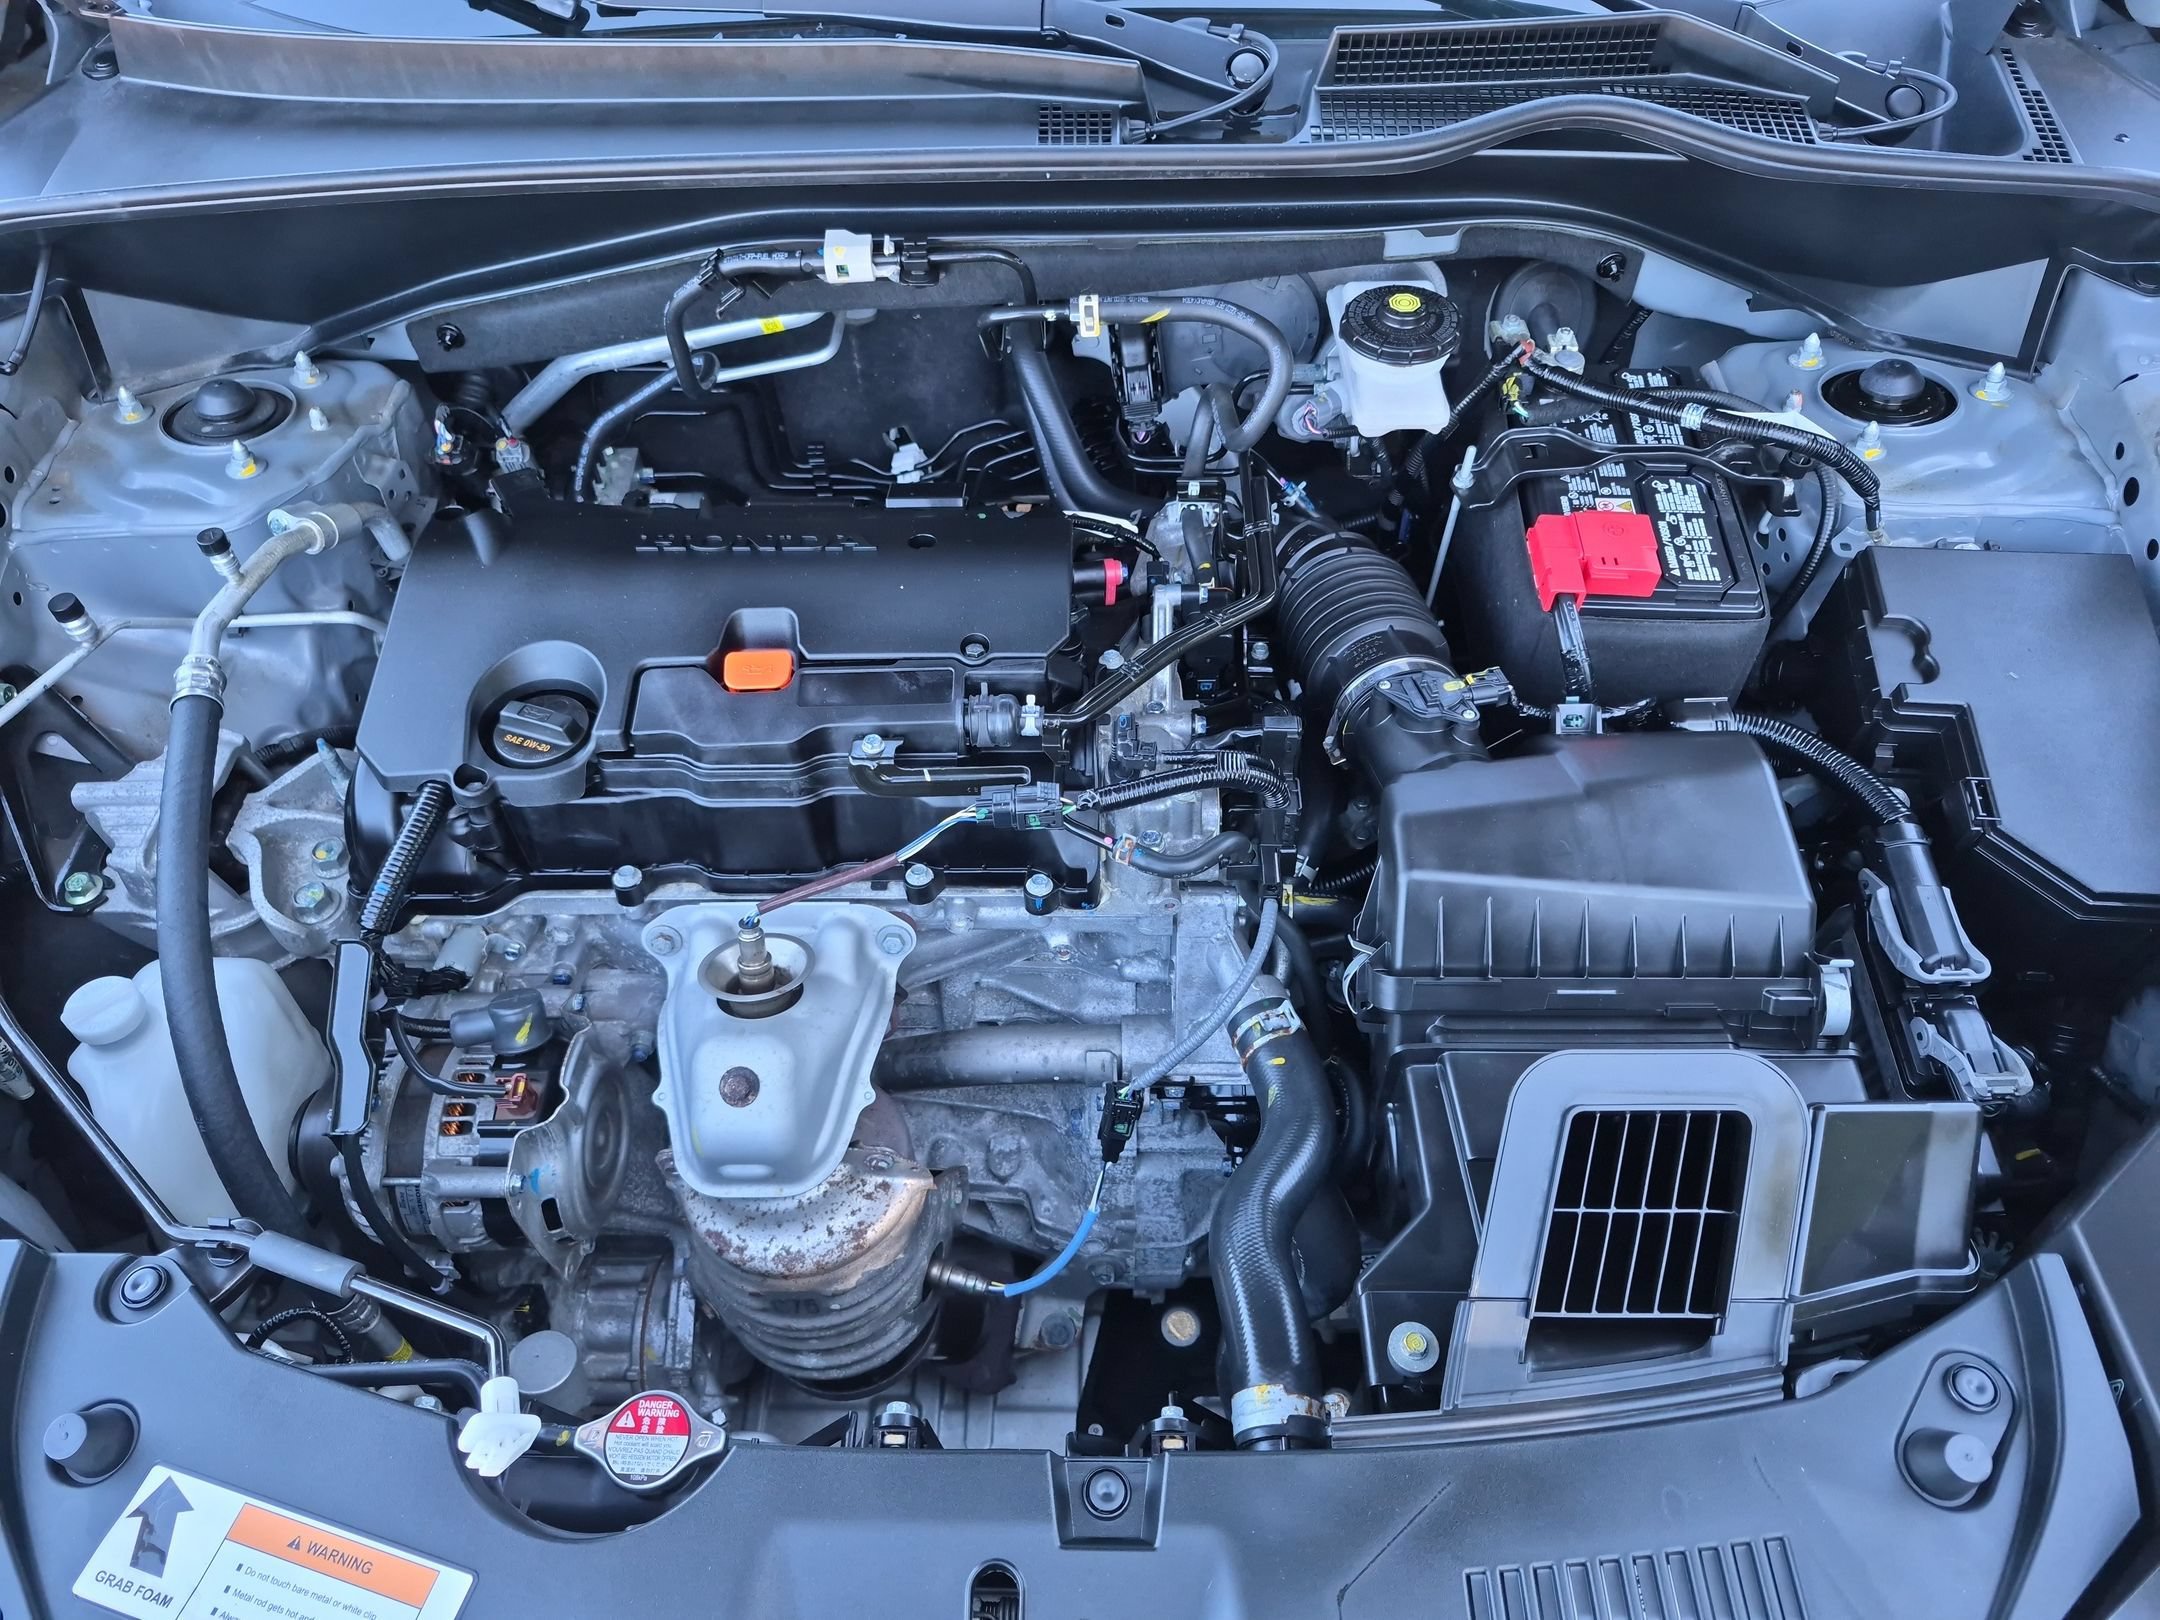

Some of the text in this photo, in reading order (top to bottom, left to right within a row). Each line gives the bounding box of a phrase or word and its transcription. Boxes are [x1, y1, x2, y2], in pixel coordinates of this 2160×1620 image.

[635, 534, 878, 552] HONDA
[504, 734, 524, 745] SAE
[522, 739, 551, 753] 0W-20
[637, 1408, 680, 1418] WARNUNG
[639, 1400, 673, 1409] DANGER
[306, 1540, 374, 1575] WARNING
[95, 1570, 174, 1609] GRAB FOAM
[244, 1566, 256, 1577] Do
[257, 1571, 270, 1582] not
[271, 1576, 291, 1590] touch
[292, 1584, 310, 1597] bare
[310, 1592, 332, 1604] metal
[332, 1600, 341, 1608] or
[342, 1603, 362, 1616] white
[232, 1588, 254, 1602] Metal
[254, 1596, 268, 1607] rod
[267, 1602, 284, 1614] gets
[285, 1608, 299, 1618] hot
